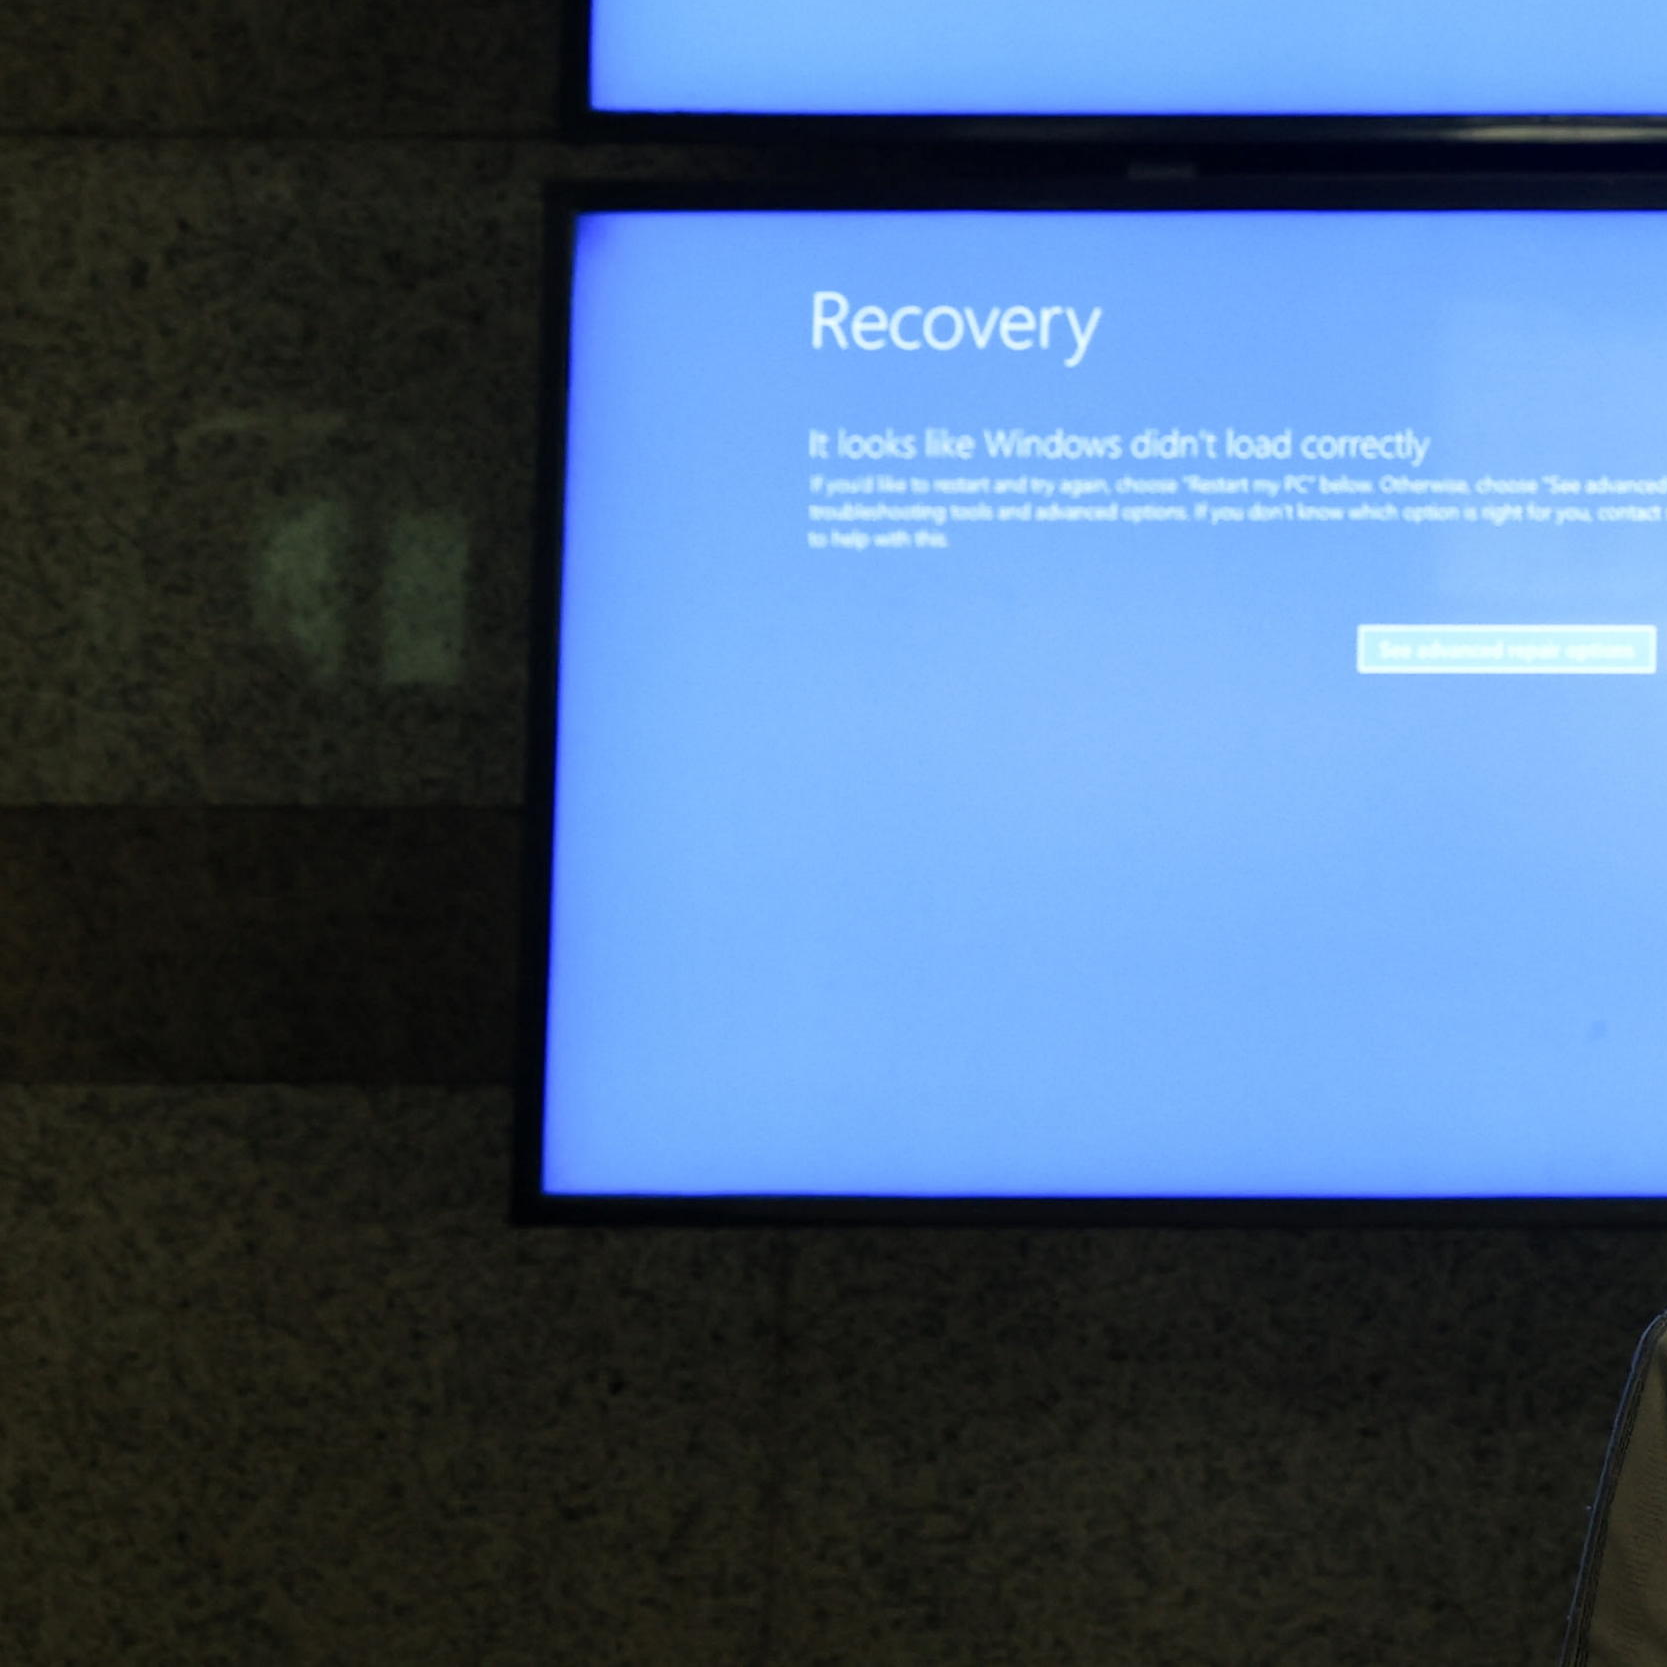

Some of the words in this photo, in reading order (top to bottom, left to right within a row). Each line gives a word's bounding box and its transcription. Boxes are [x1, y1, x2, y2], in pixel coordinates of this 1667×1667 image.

[811, 290, 1104, 368] Recovery
[808, 428, 830, 460] It
[836, 427, 917, 460] looks
[925, 427, 976, 460] like
[983, 427, 1123, 460] Windows
[1130, 427, 1218, 460] didn't
[1225, 427, 1292, 460] load
[1303, 427, 1431, 467] correctly
